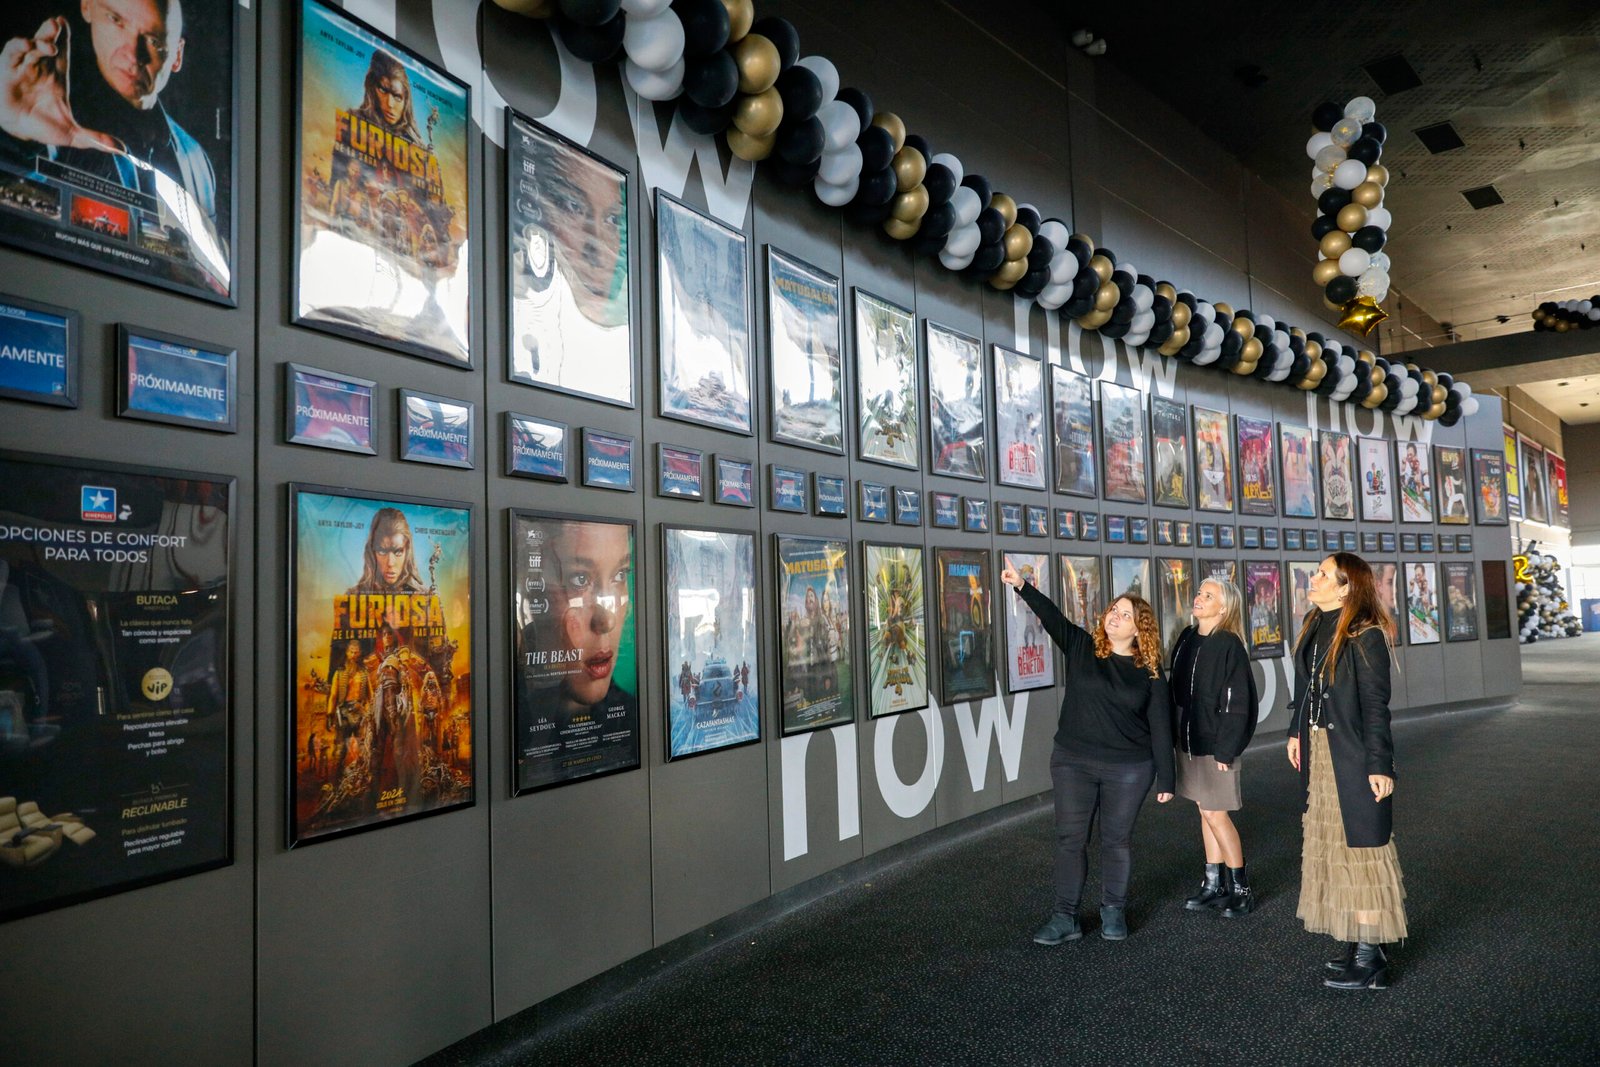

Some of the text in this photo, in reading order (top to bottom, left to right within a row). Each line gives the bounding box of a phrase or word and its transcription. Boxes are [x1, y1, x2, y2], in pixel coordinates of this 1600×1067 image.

[335, 107, 441, 186] FURIOSA
[1, 345, 65, 368] AMENTE
[130, 372, 225, 401] PRÓXIMAMENTE
[296, 405, 369, 427] PRÓXIMAMENTE
[408, 425, 467, 445] PRÓXIMAMENTE
[513, 445, 563, 461] PRÓXIMAMENTE
[588, 456, 630, 471] PRÓXIMAMENTE
[663, 471, 700, 484] PRÓXIMAMENTE
[0, 526, 187, 548] OPCIONES DE CONFORT
[45, 547, 148, 563] PARA TODOS
[529, 555, 542, 568] tiff
[136, 595, 178, 605] BUTACA
[333, 594, 444, 628] FURIOSA
[525, 648, 584, 665] THE BEAST
[606, 711, 626, 719] MACKAY
[529, 723, 556, 732] SEYDOUX
[380, 788, 404, 801] 2024
[122, 797, 188, 819] RECLINABLE
